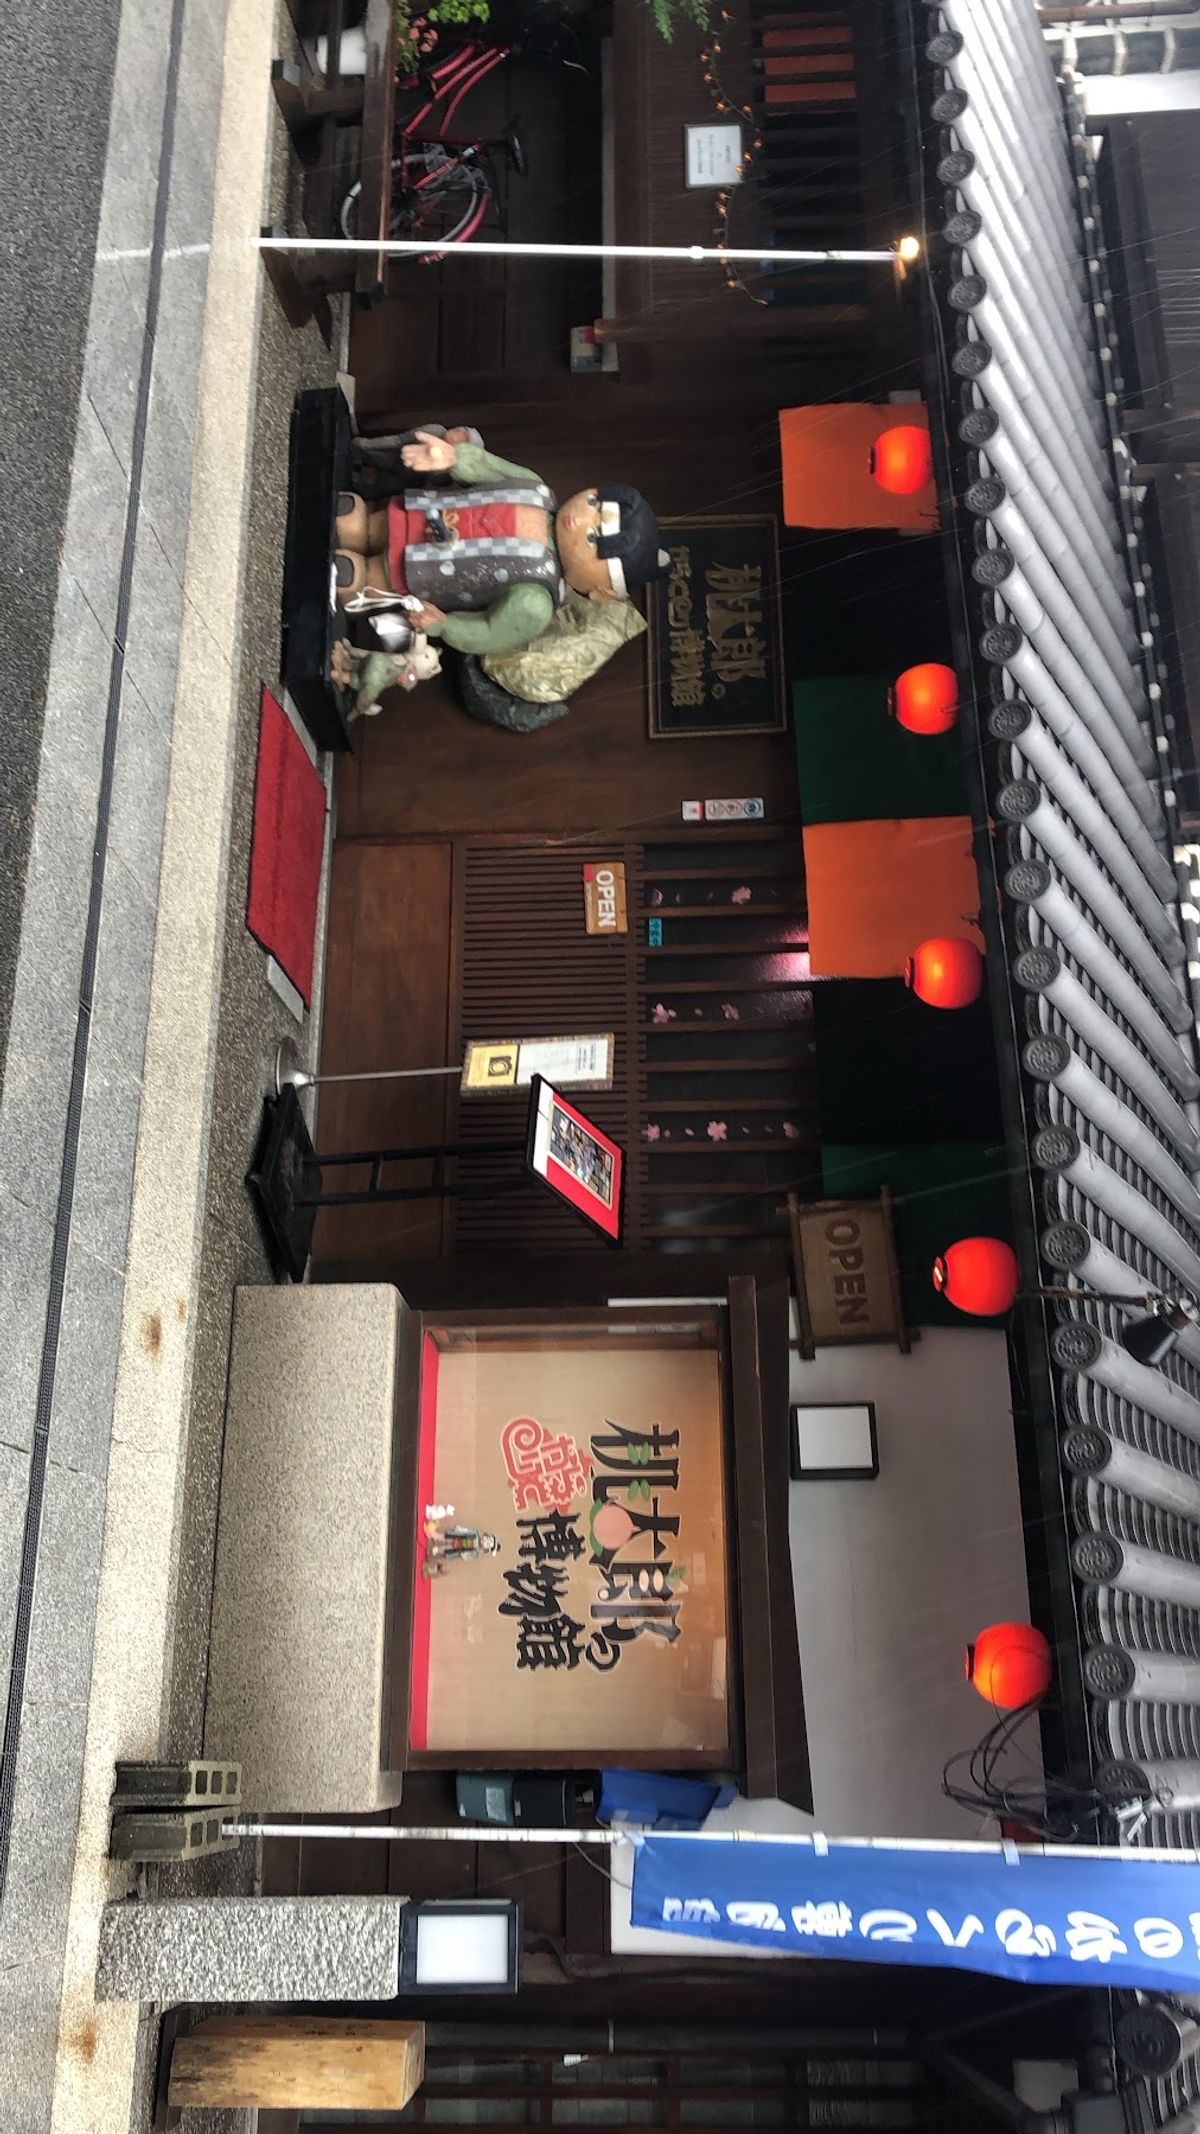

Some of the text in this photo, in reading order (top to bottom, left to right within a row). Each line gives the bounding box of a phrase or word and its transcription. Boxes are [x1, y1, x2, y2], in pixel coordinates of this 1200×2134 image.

[705, 561, 767, 700] 桃太郎の
[596, 870, 617, 928] OPEN
[825, 1219, 870, 1325] OPEN
[586, 1418, 683, 1671] 桃太郎の
